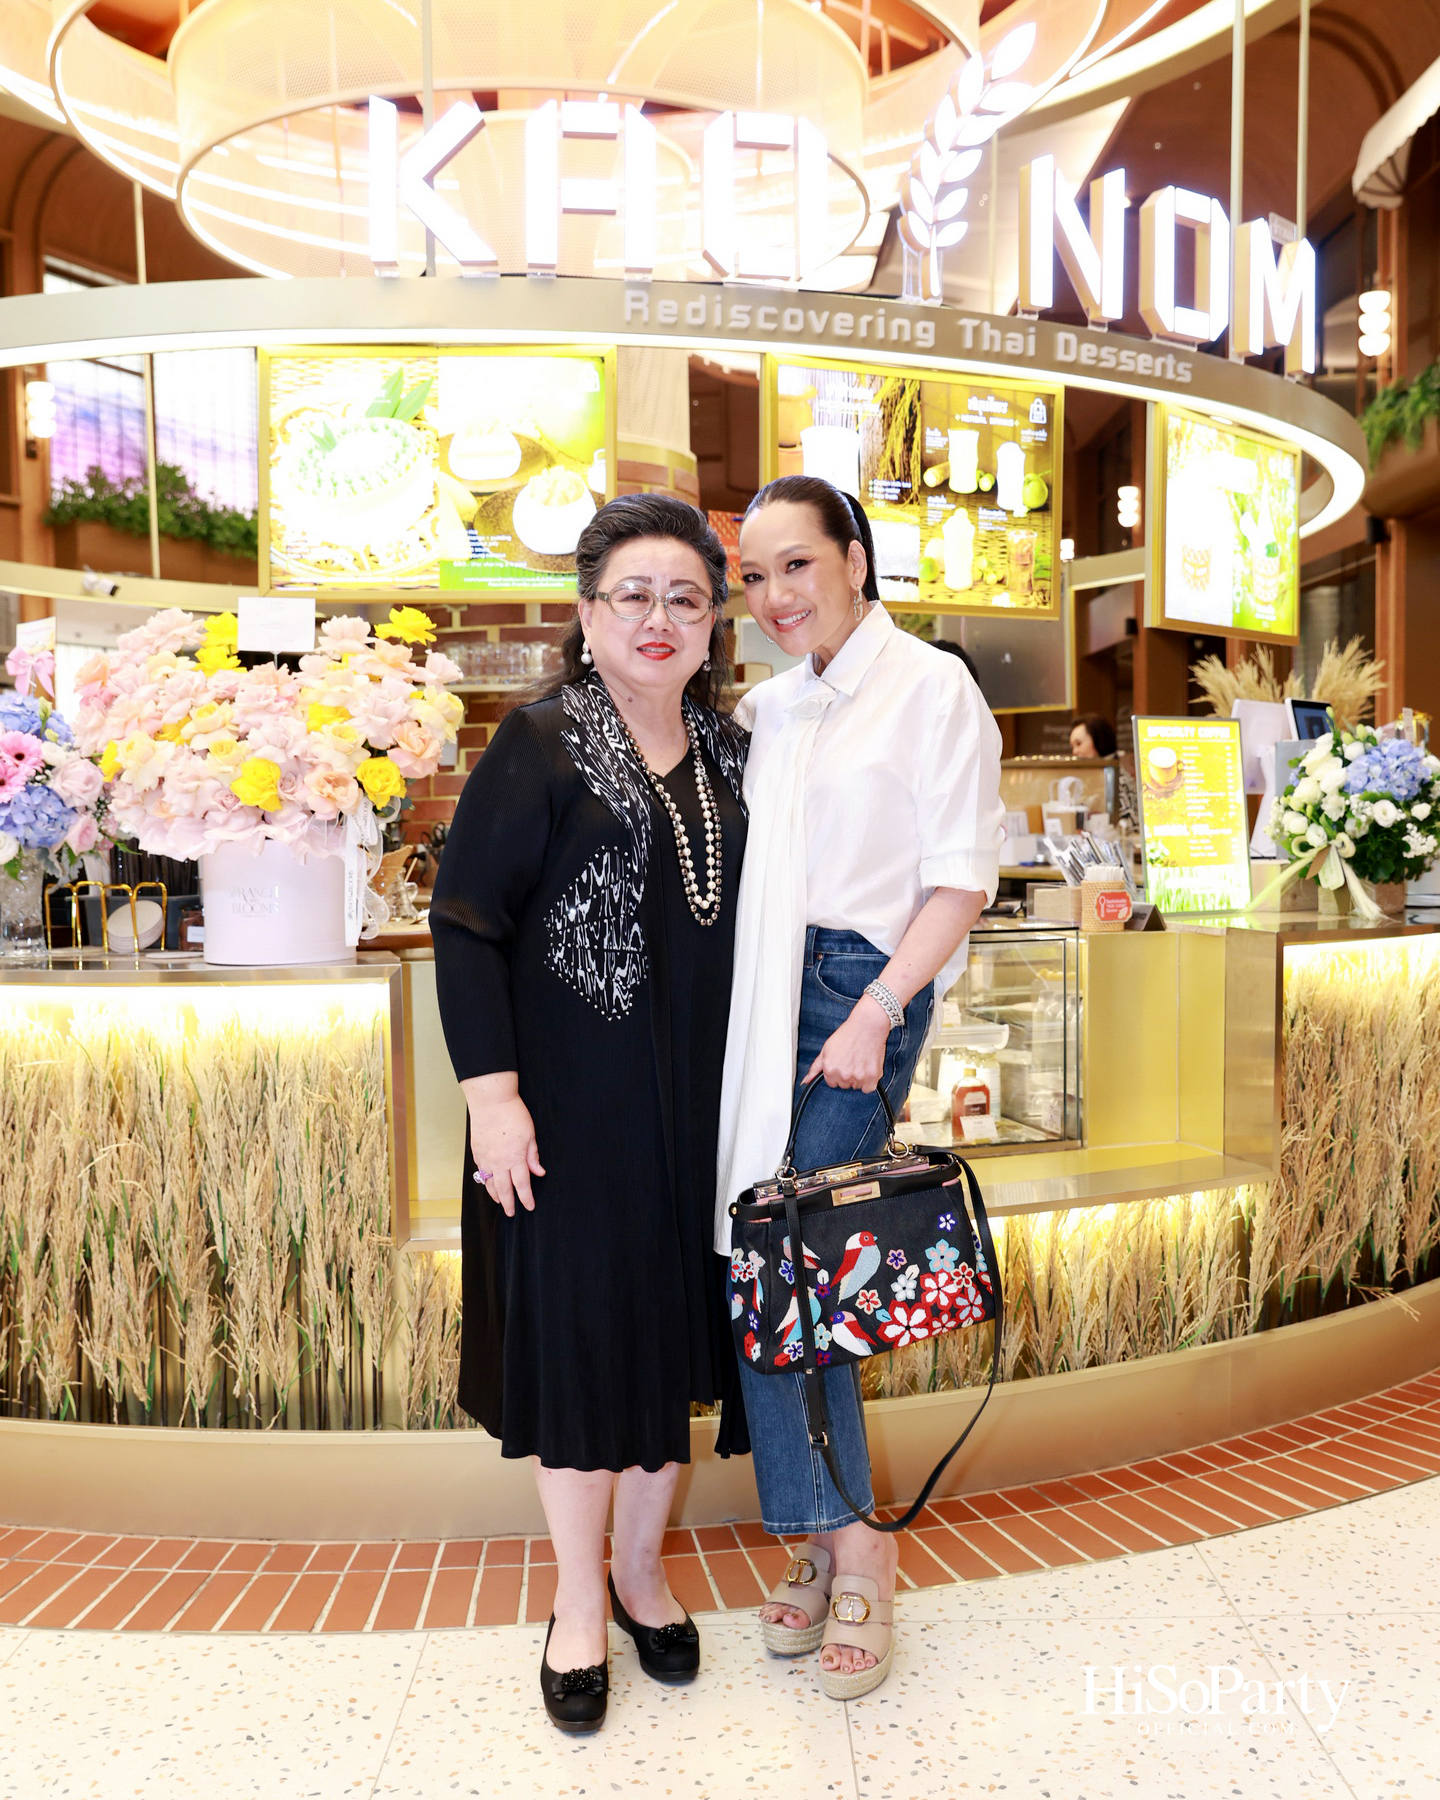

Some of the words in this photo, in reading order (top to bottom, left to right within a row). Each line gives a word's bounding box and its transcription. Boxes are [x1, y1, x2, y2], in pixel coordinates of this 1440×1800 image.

[624, 289, 935, 348] Rediscovering
[958, 318, 1036, 357] Thai
[1056, 332, 1193, 384] Desserts
[1019, 153, 1316, 374] NOM
